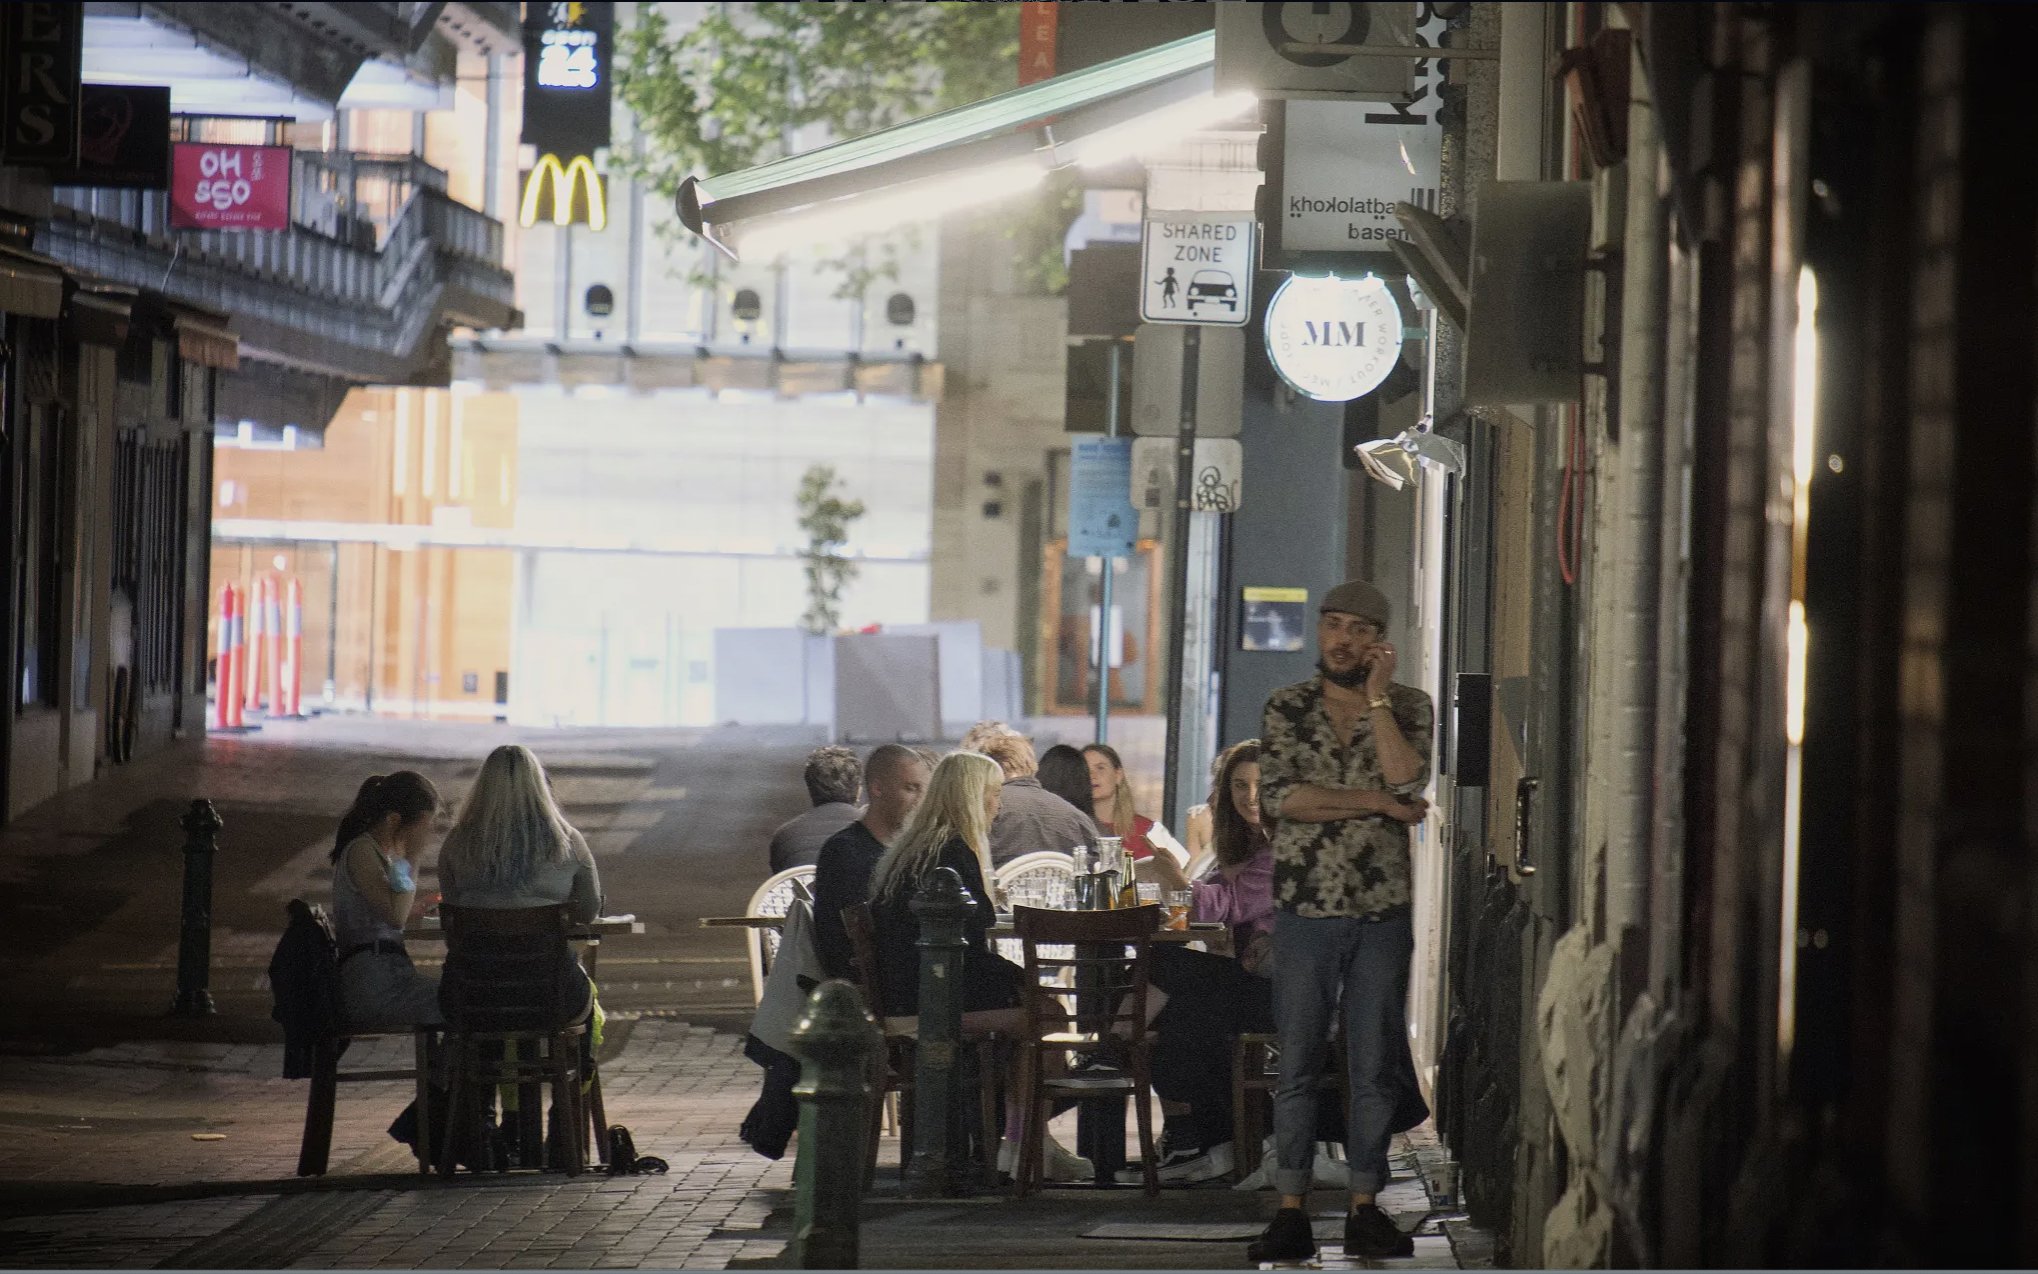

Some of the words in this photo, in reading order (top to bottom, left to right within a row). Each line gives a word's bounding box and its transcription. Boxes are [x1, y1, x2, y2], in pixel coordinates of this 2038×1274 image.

[1034, 2, 1050, 82] LEA
[200, 149, 241, 179] OH
[1162, 222, 1237, 241] SHARED
[1174, 245, 1223, 263] ZONE
[1301, 320, 1367, 347] MM
[1351, 323, 1387, 384] WORKOUT
